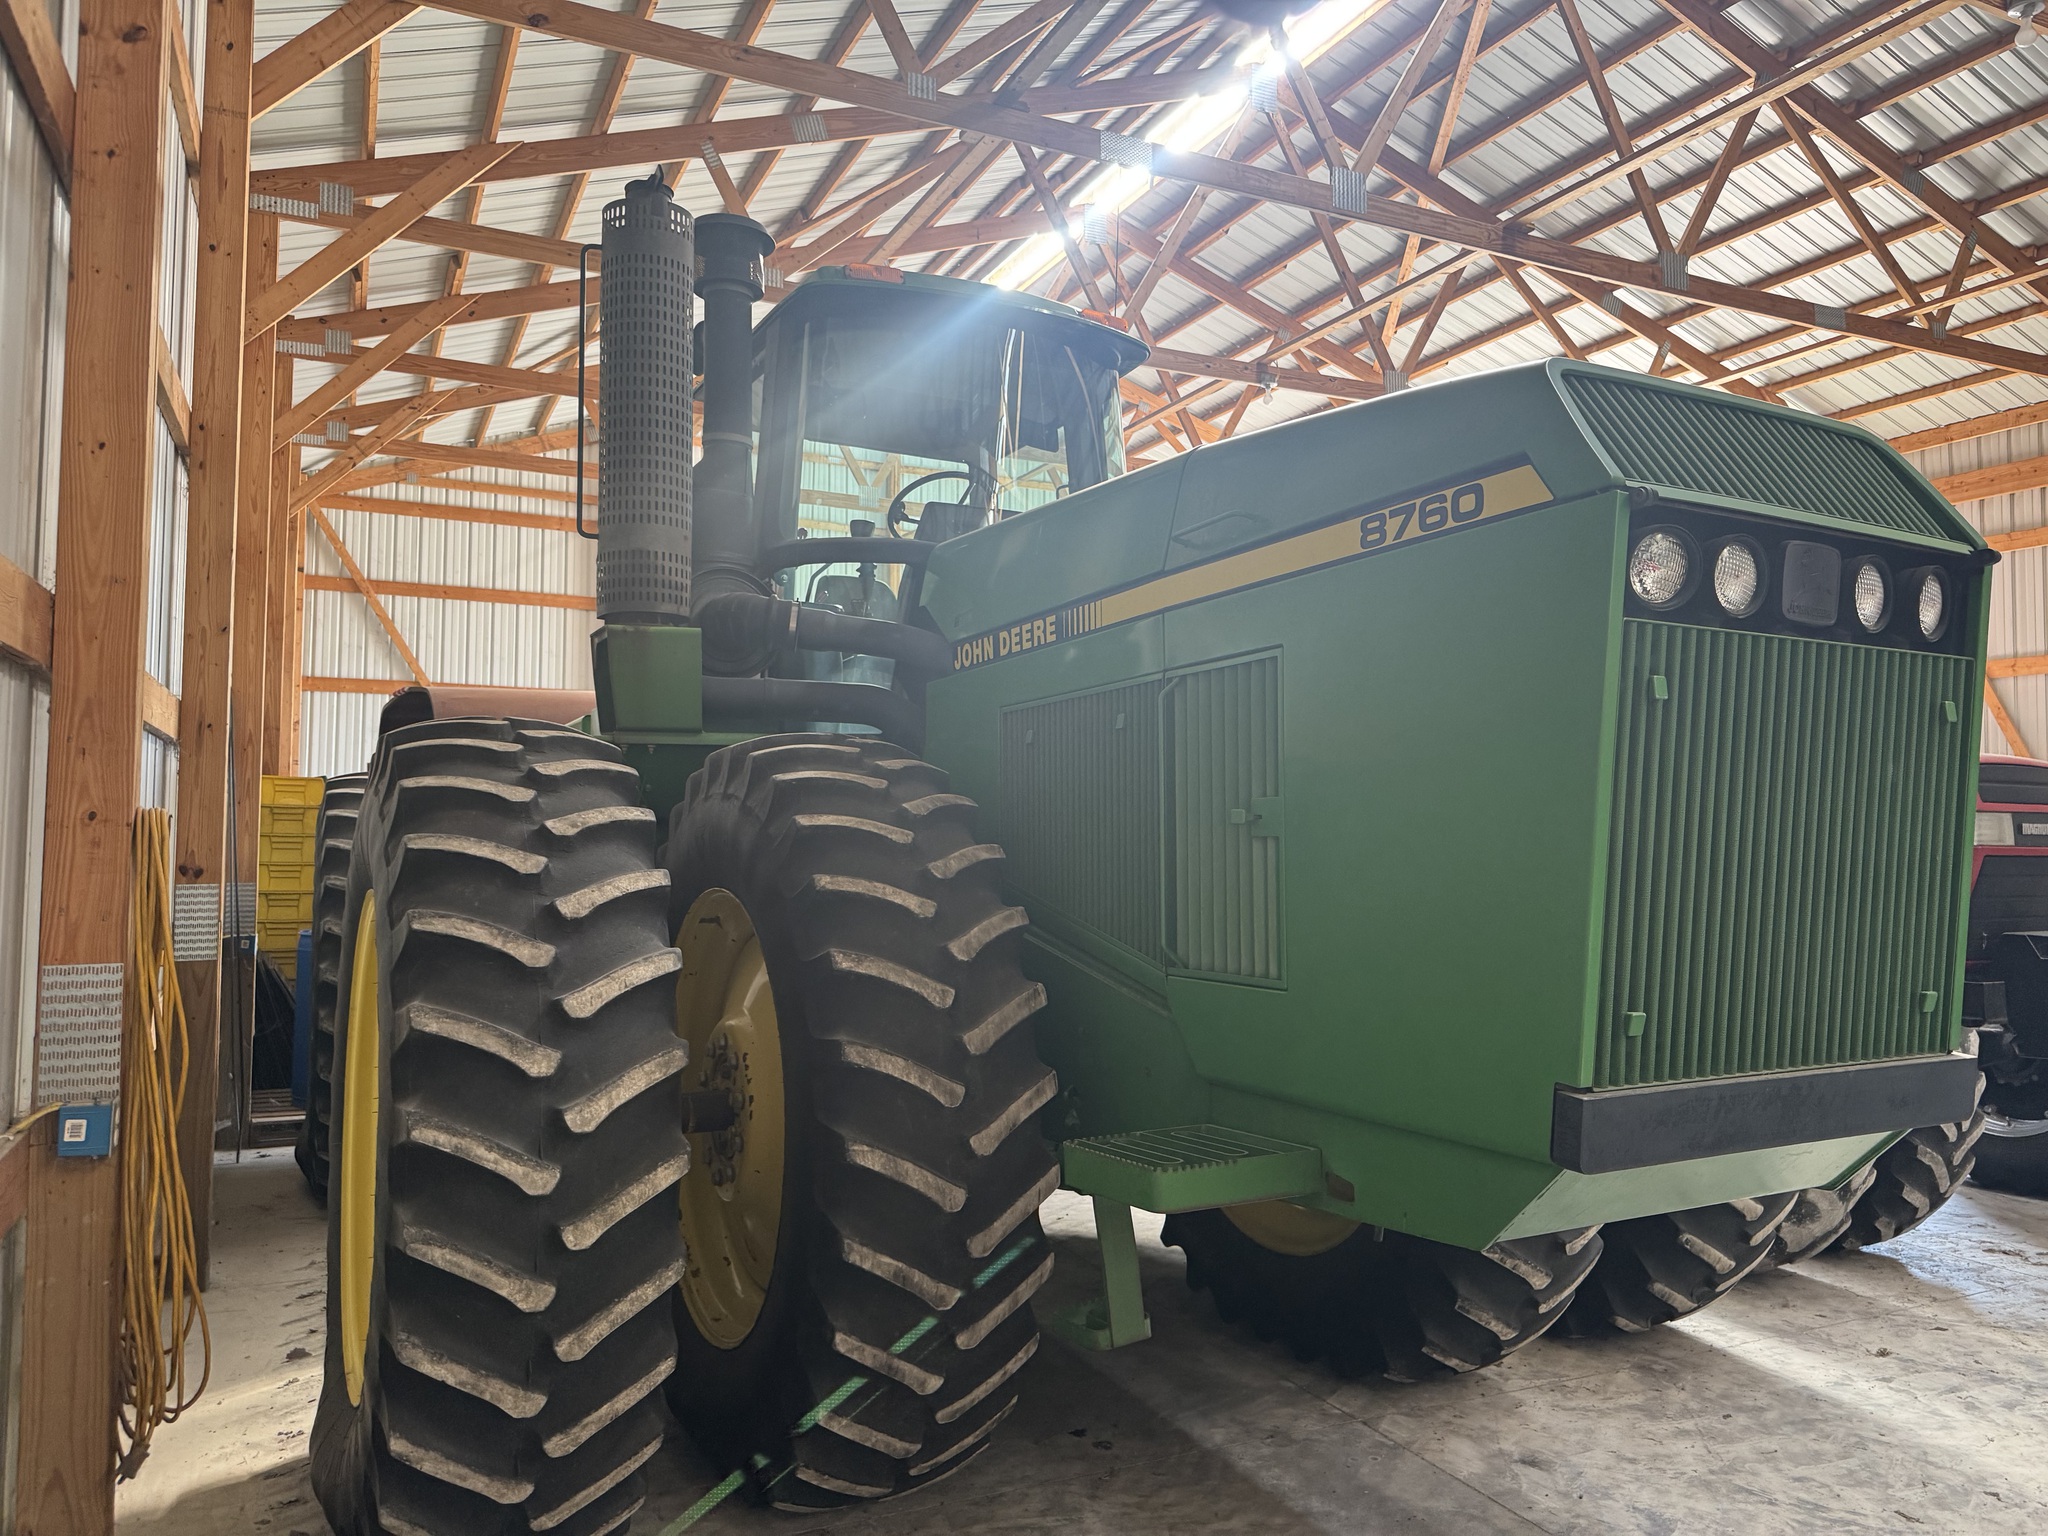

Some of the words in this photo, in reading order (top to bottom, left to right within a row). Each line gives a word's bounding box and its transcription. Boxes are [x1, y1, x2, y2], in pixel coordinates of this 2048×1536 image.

[1360, 482, 1485, 550] 8760
[954, 635, 994, 670] JOHN
[999, 614, 1057, 657] DEERE
